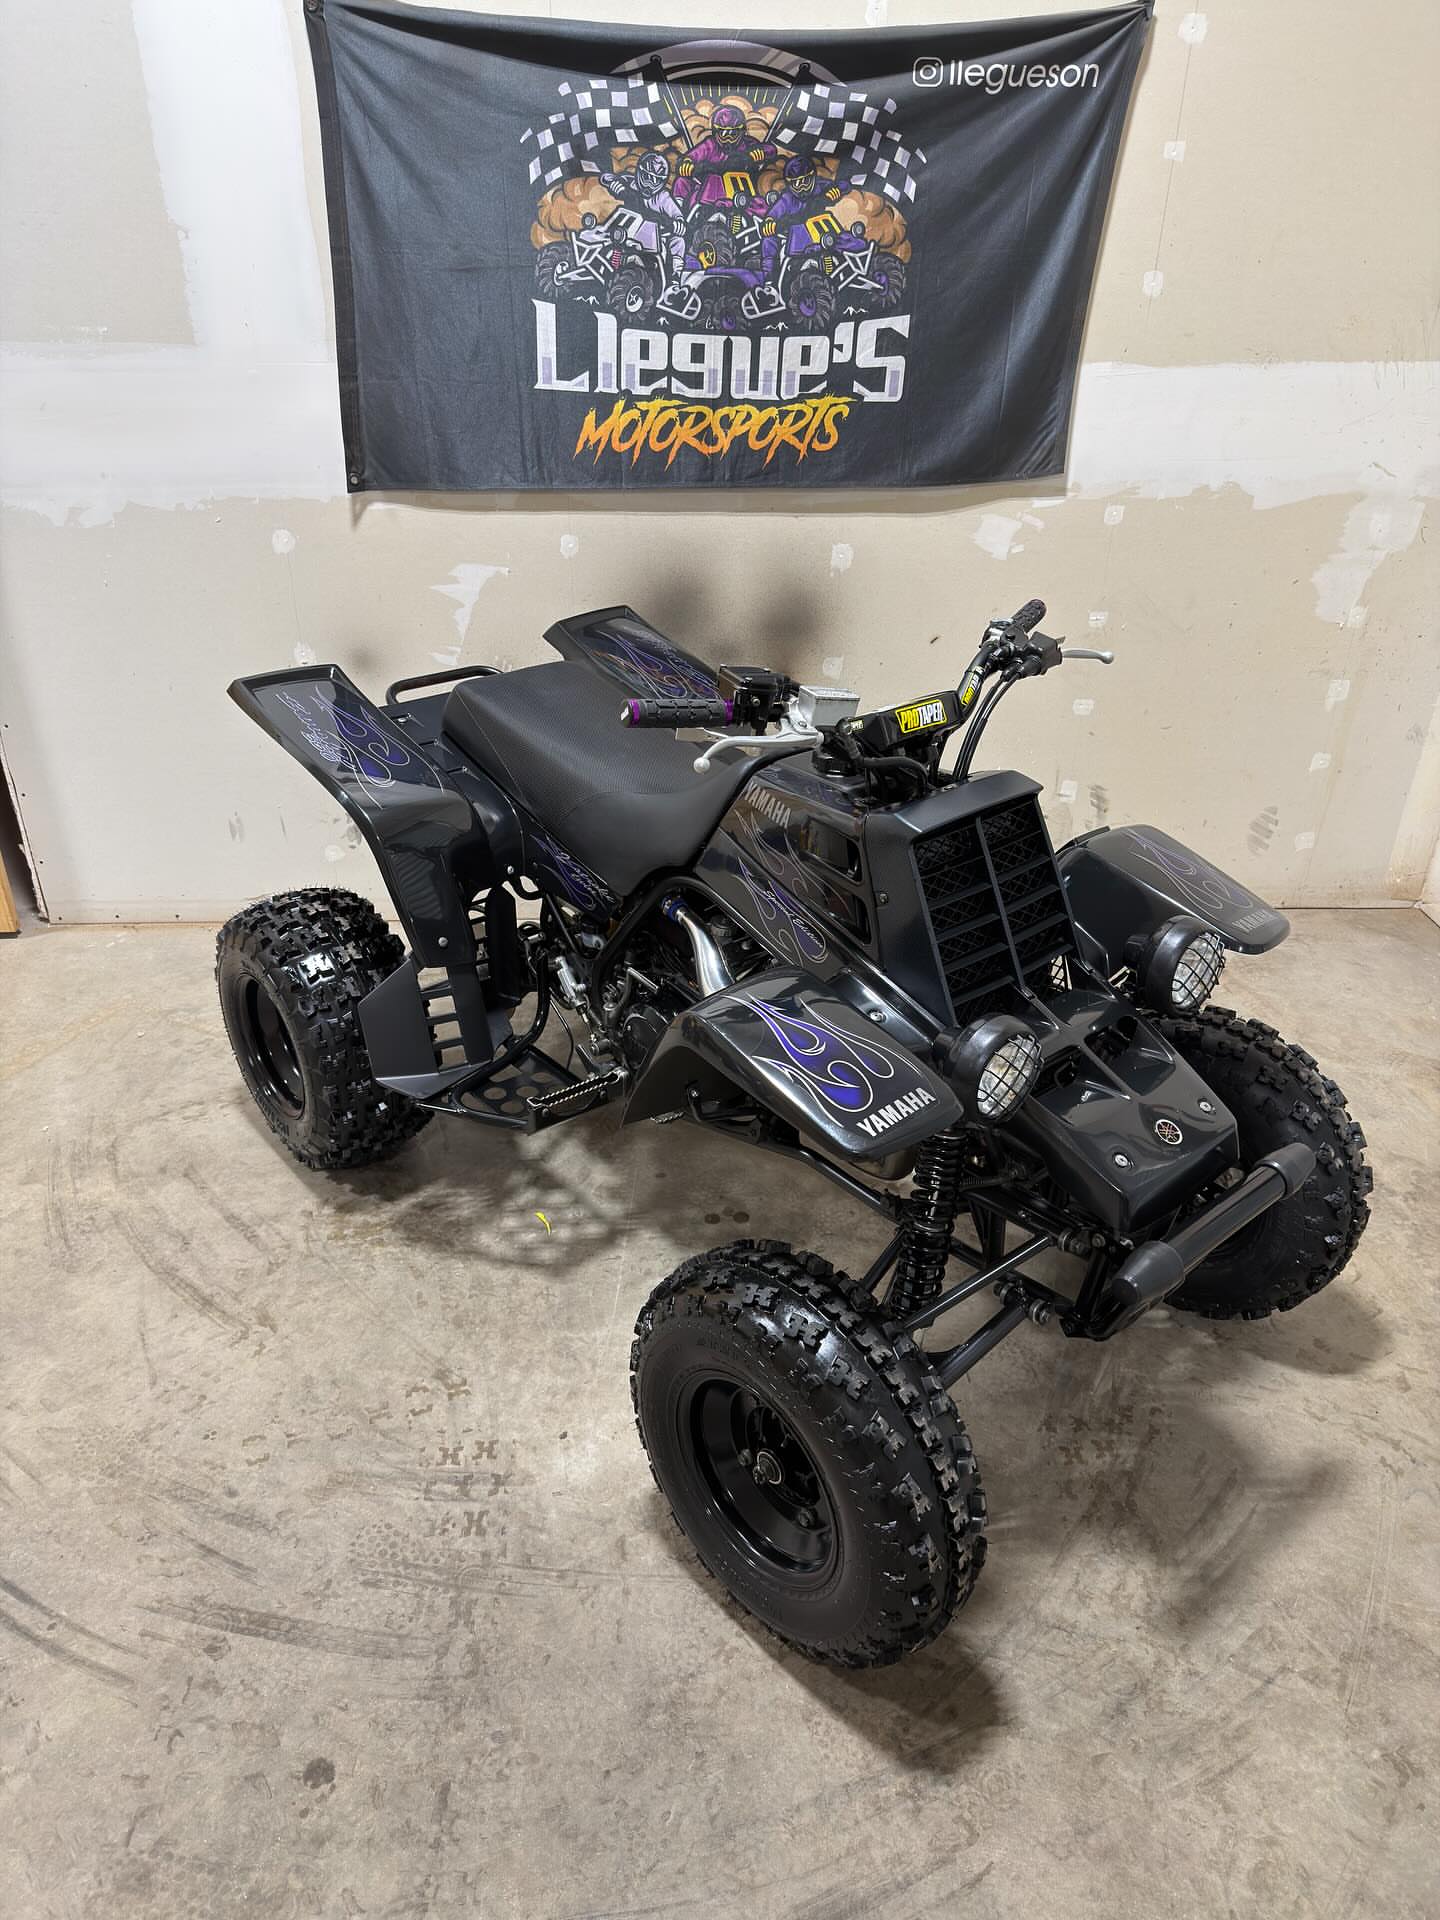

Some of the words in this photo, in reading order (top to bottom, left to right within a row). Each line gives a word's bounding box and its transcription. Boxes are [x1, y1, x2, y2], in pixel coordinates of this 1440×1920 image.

[950, 60, 1100, 95] llegueson
[573, 395, 858, 471] MOTORSPORTS
[901, 702, 944, 727] PROTAPER
[745, 781, 791, 828] YAMAHA
[856, 1087, 936, 1137] YAMAHA
